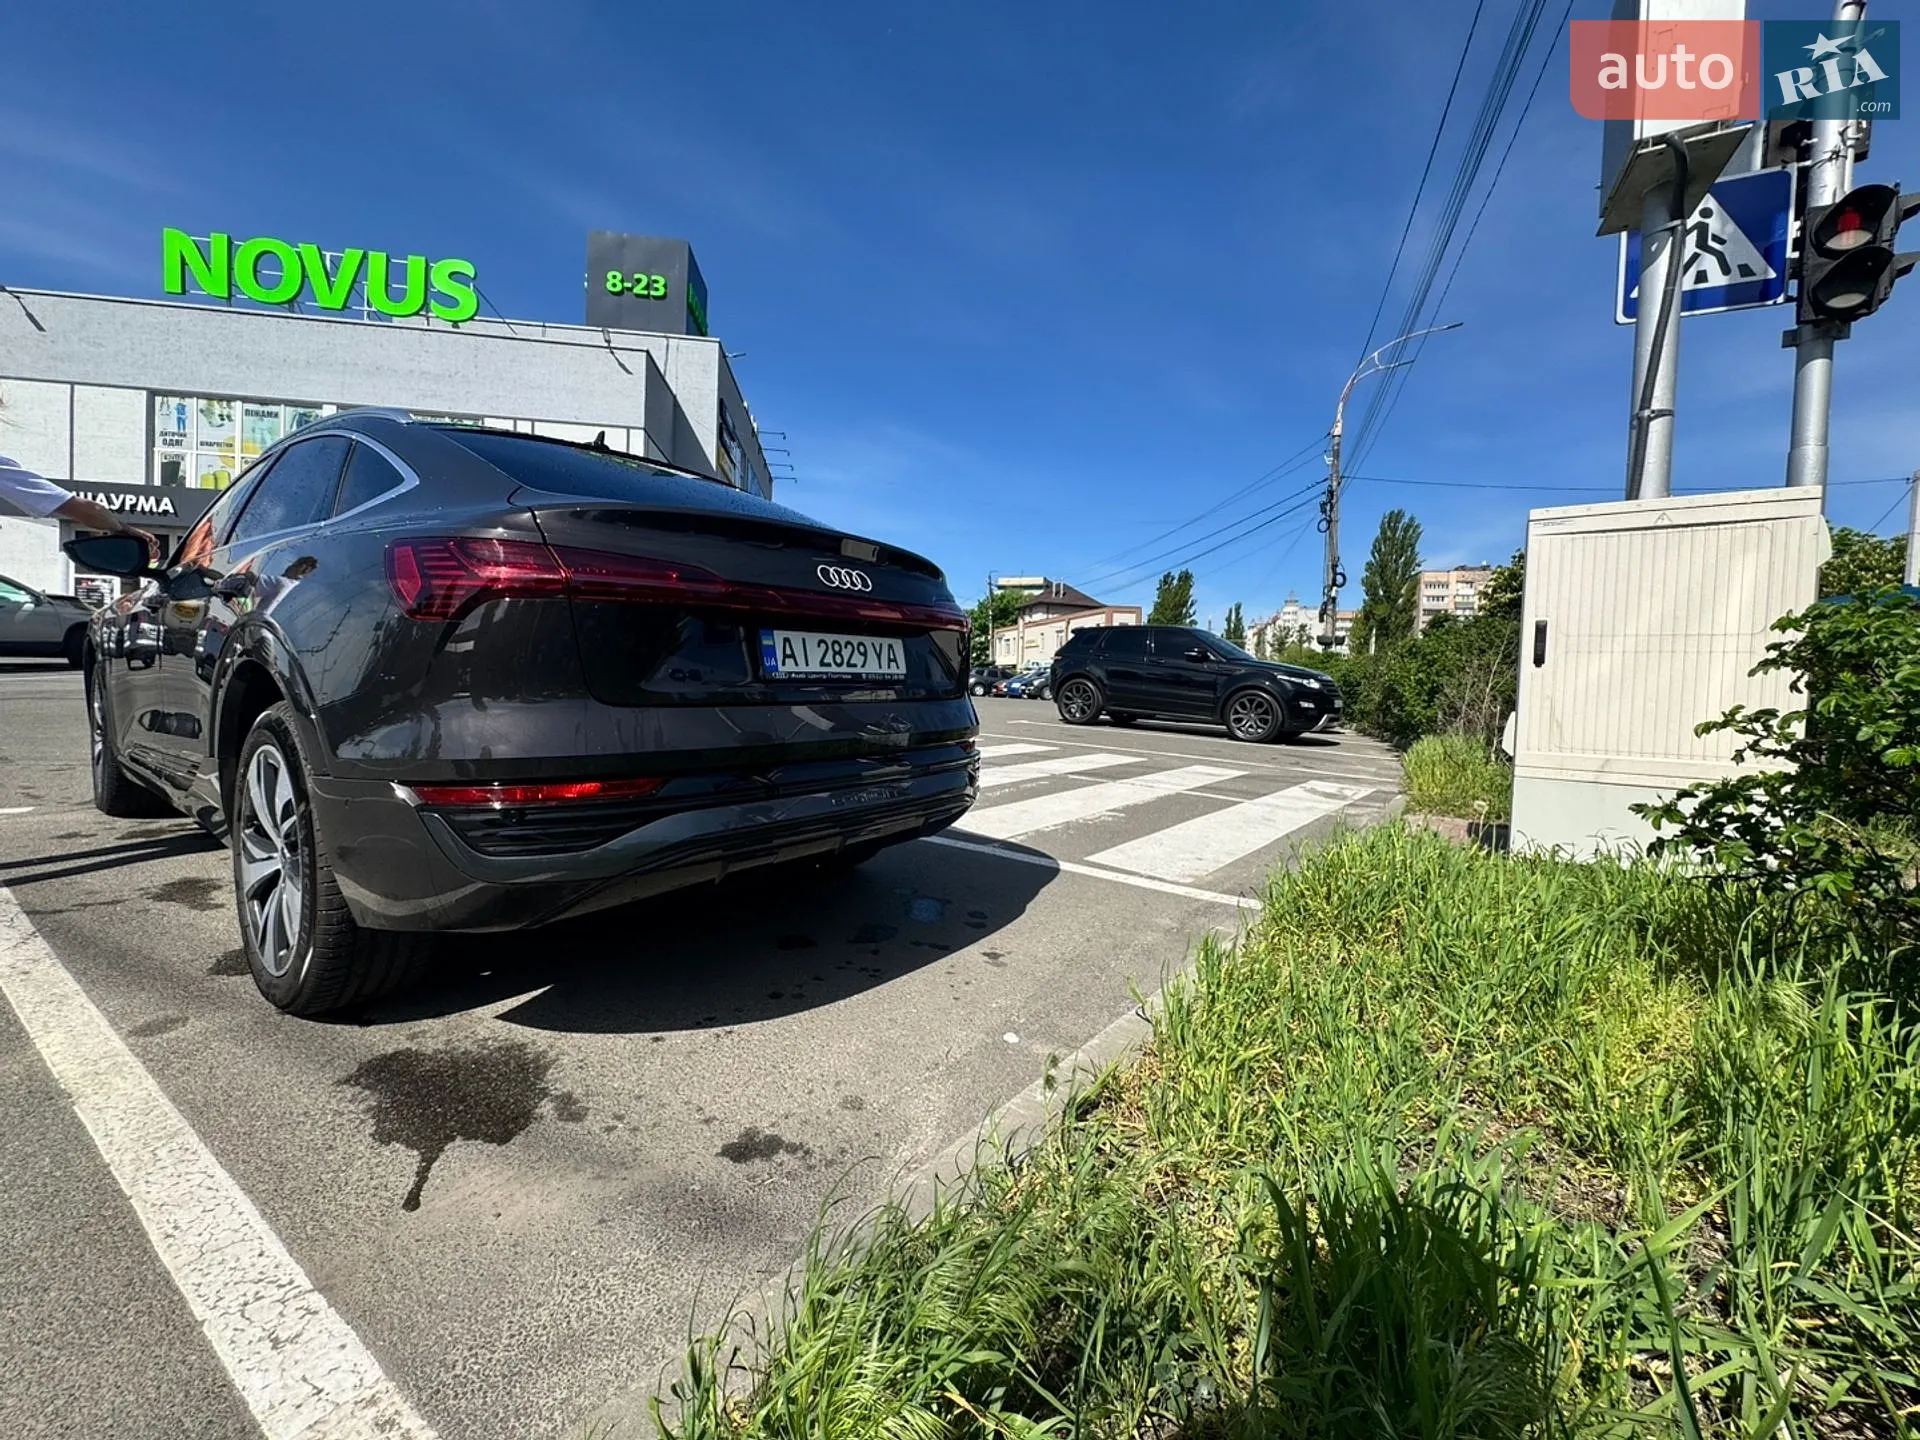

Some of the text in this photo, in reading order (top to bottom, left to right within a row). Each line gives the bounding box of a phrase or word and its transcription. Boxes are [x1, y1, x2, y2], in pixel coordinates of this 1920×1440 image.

[162, 227, 478, 322] NOVUS
[605, 270, 667, 300] 8-23
[162, 438, 184, 447] ОДЯГ
[764, 636, 900, 670] UA AI 2829 YA
